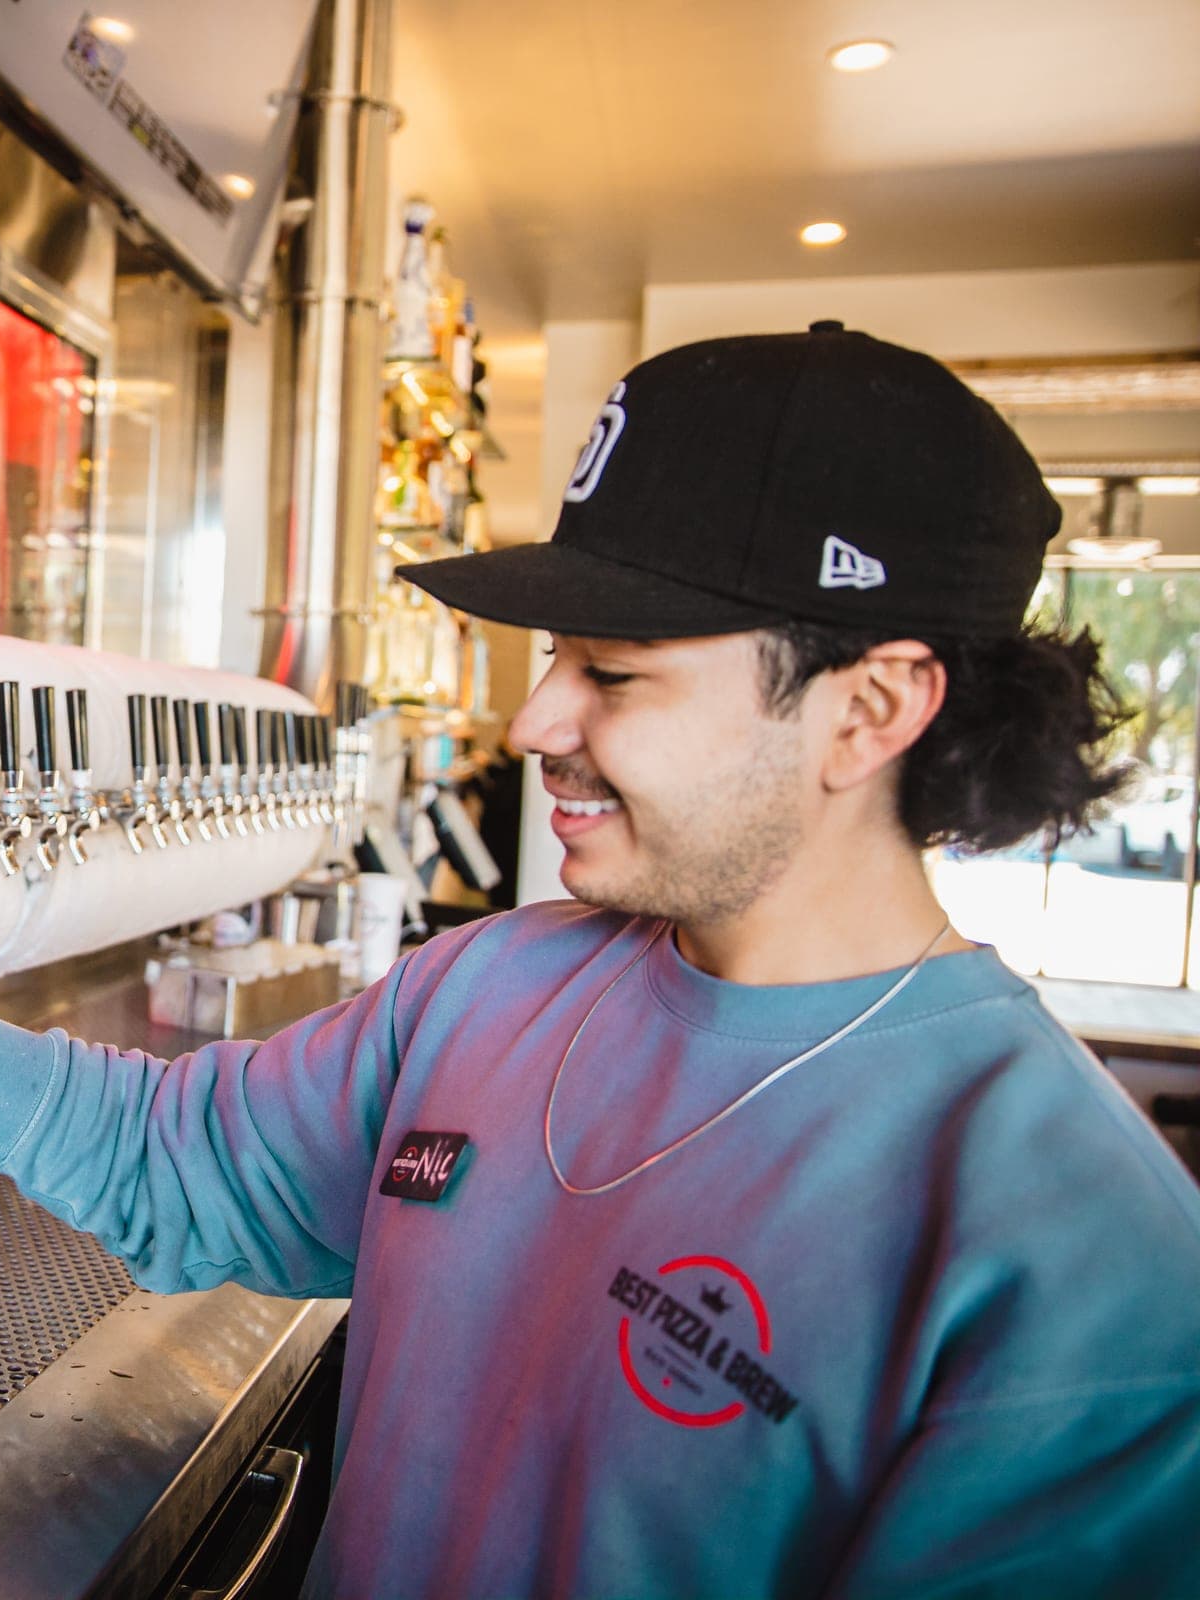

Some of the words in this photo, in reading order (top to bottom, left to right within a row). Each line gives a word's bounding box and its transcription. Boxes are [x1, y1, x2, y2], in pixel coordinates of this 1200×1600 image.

[608, 1266, 662, 1317] BEST
[650, 1293, 713, 1359] PIZZA
[706, 1336, 732, 1373] &
[722, 1350, 799, 1426] BREW
